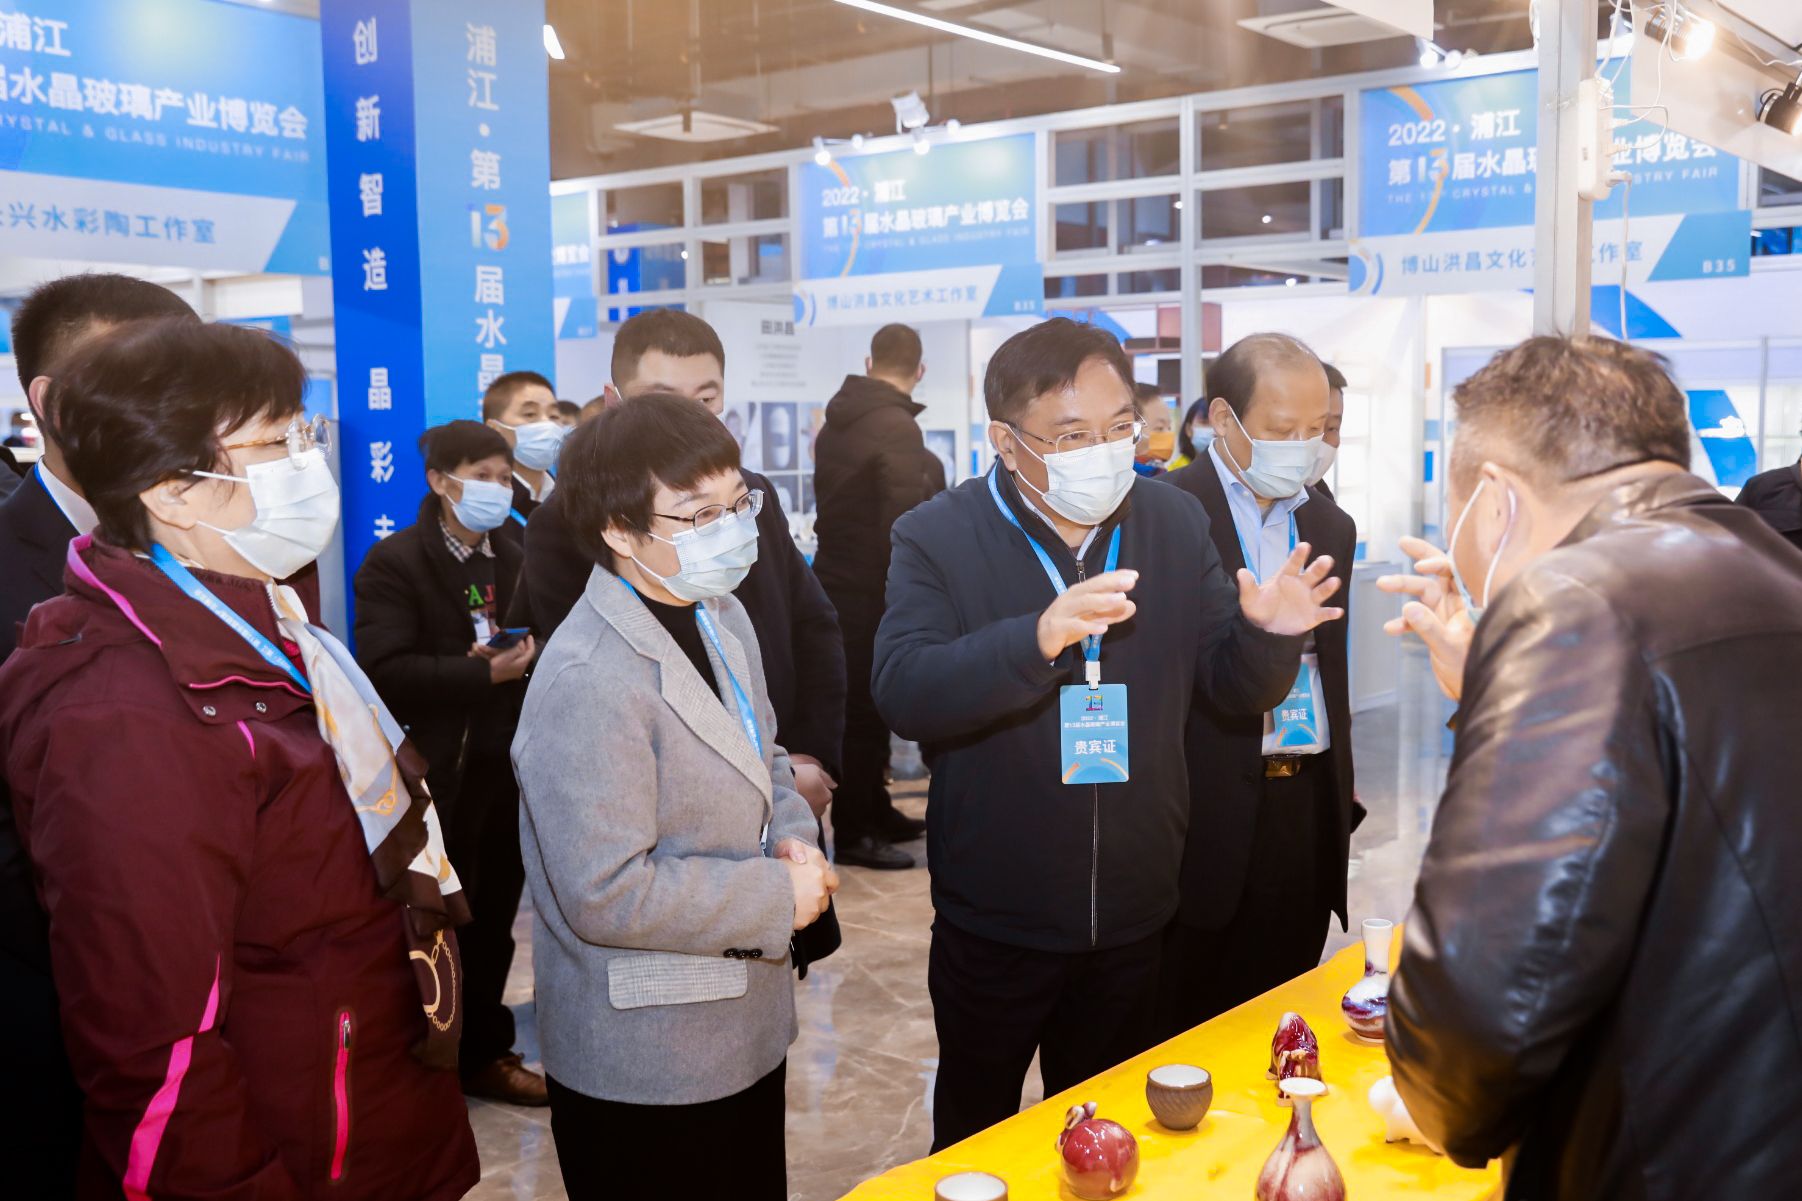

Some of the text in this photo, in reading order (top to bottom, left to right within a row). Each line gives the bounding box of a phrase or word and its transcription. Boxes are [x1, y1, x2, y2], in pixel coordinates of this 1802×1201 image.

[0, 63, 309, 140] 水晶玻璃产业博览会
[0, 112, 71, 137] YSTAL
[0, 201, 216, 244] 兴水彩陶工作室
[466, 22, 509, 417] 浦江·第13届水晶
[1401, 248, 1536, 275] 博山洪昌文化
[1702, 259, 1737, 273] B35
[1074, 739, 1117, 755] 贵宾证
